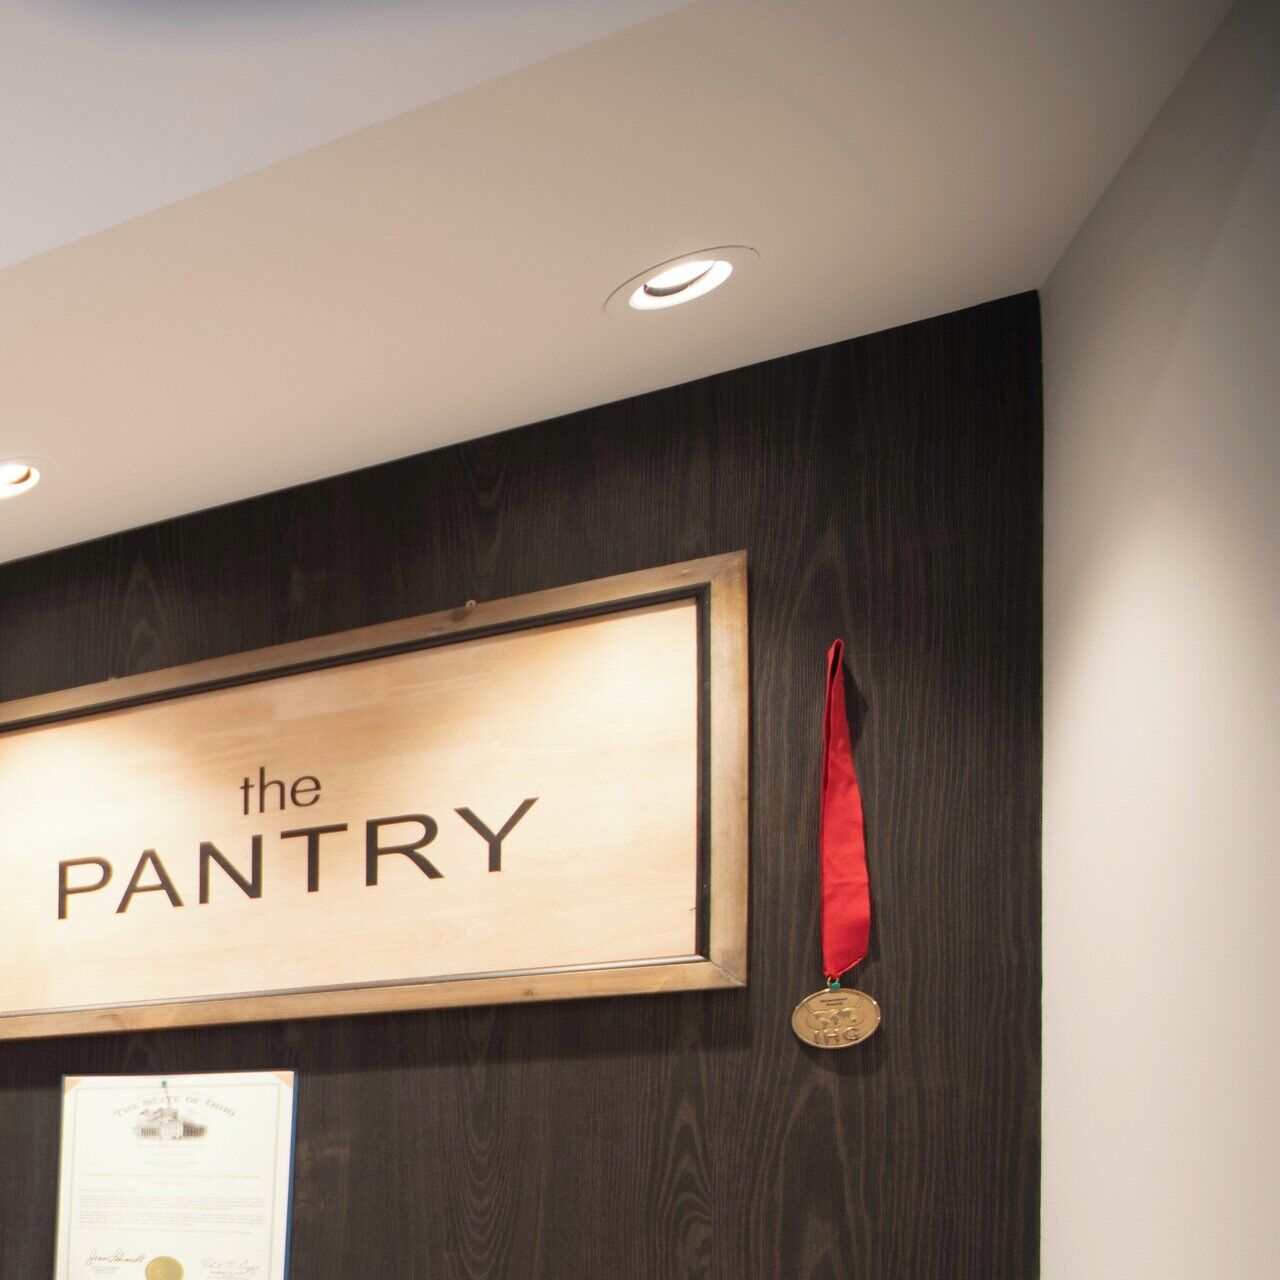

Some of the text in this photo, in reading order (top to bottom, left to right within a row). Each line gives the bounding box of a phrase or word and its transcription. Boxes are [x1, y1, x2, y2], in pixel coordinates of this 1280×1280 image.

[241, 766, 321, 816] the
[56, 797, 540, 920] PANTRY
[814, 1026, 860, 1044] IHG
[113, 1103, 138, 1118] THE
[185, 1096, 201, 1105] OF
